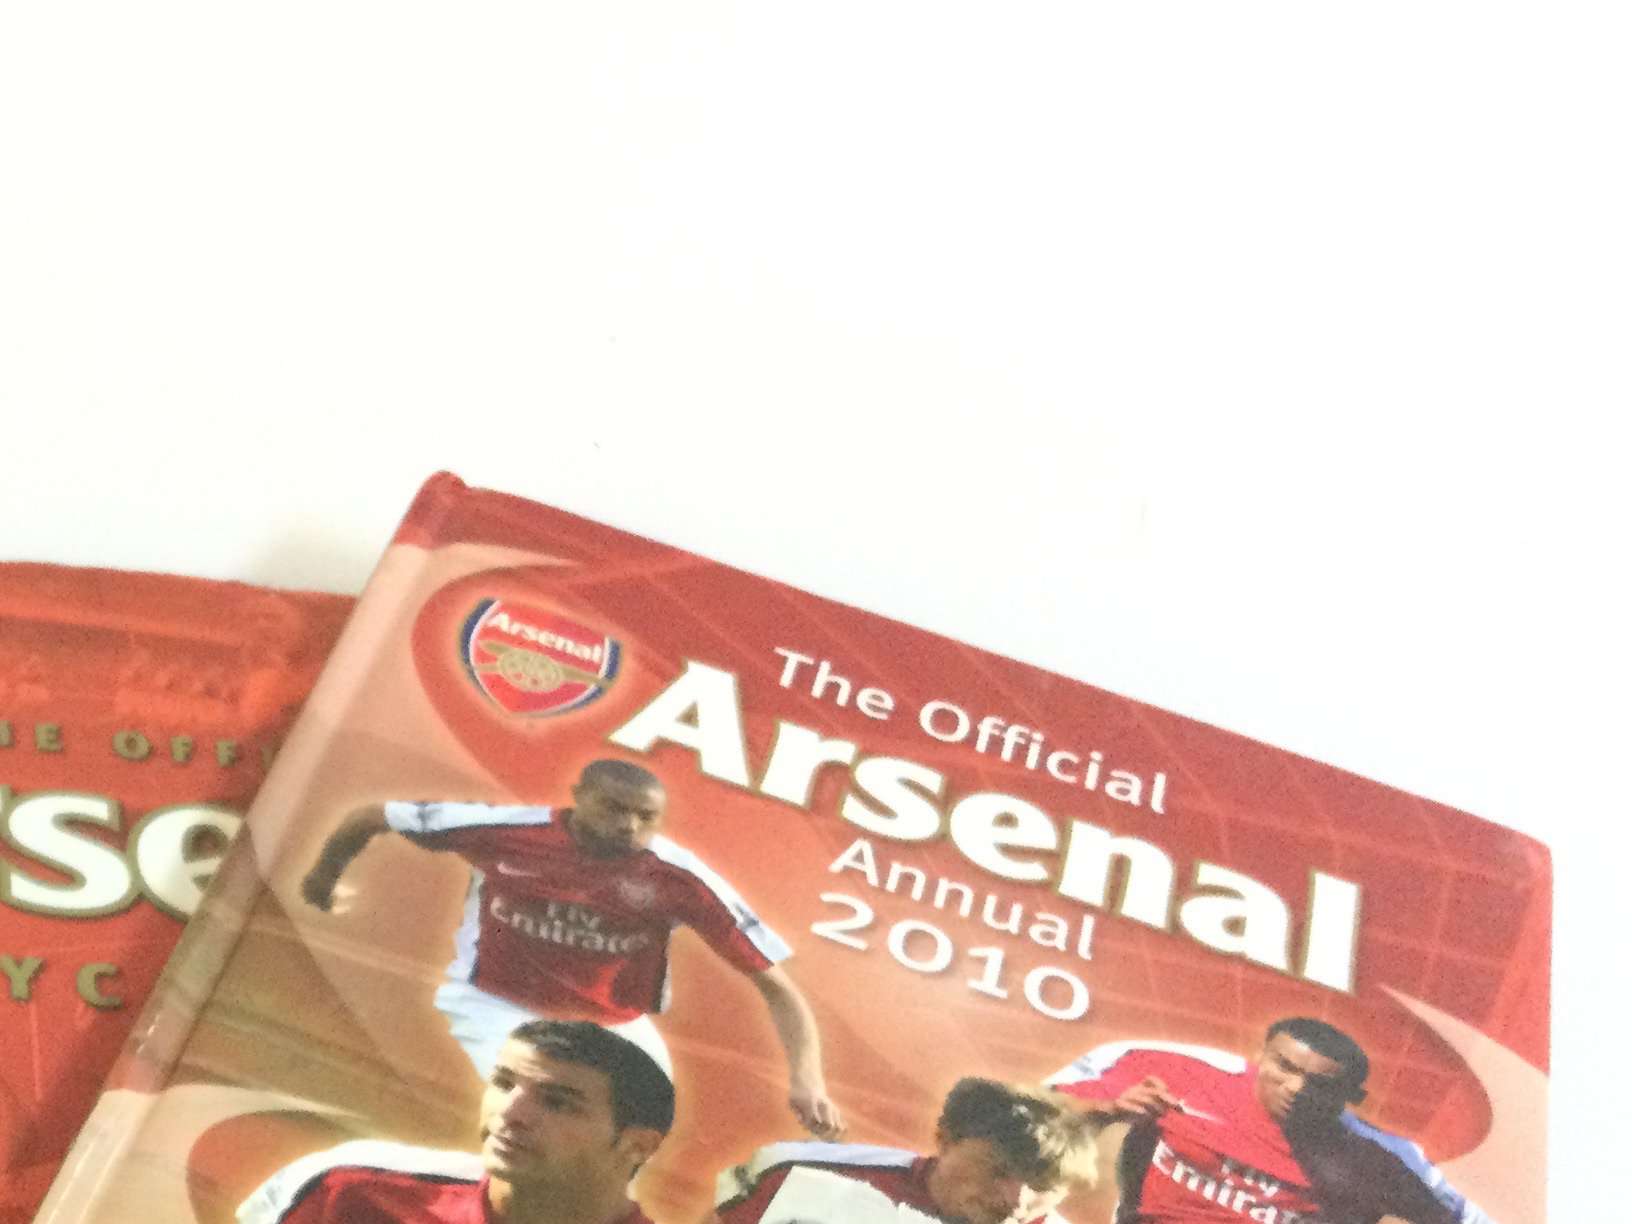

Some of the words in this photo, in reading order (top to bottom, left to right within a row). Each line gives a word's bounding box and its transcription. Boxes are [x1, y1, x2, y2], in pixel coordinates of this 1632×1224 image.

[485, 612, 602, 663] Arsenal
[773, 647, 895, 721] The
[919, 700, 1167, 813] Official
[609, 659, 1361, 994] Arsenal
[811, 894, 1091, 1023] 2010
[828, 838, 1096, 959] Annual
